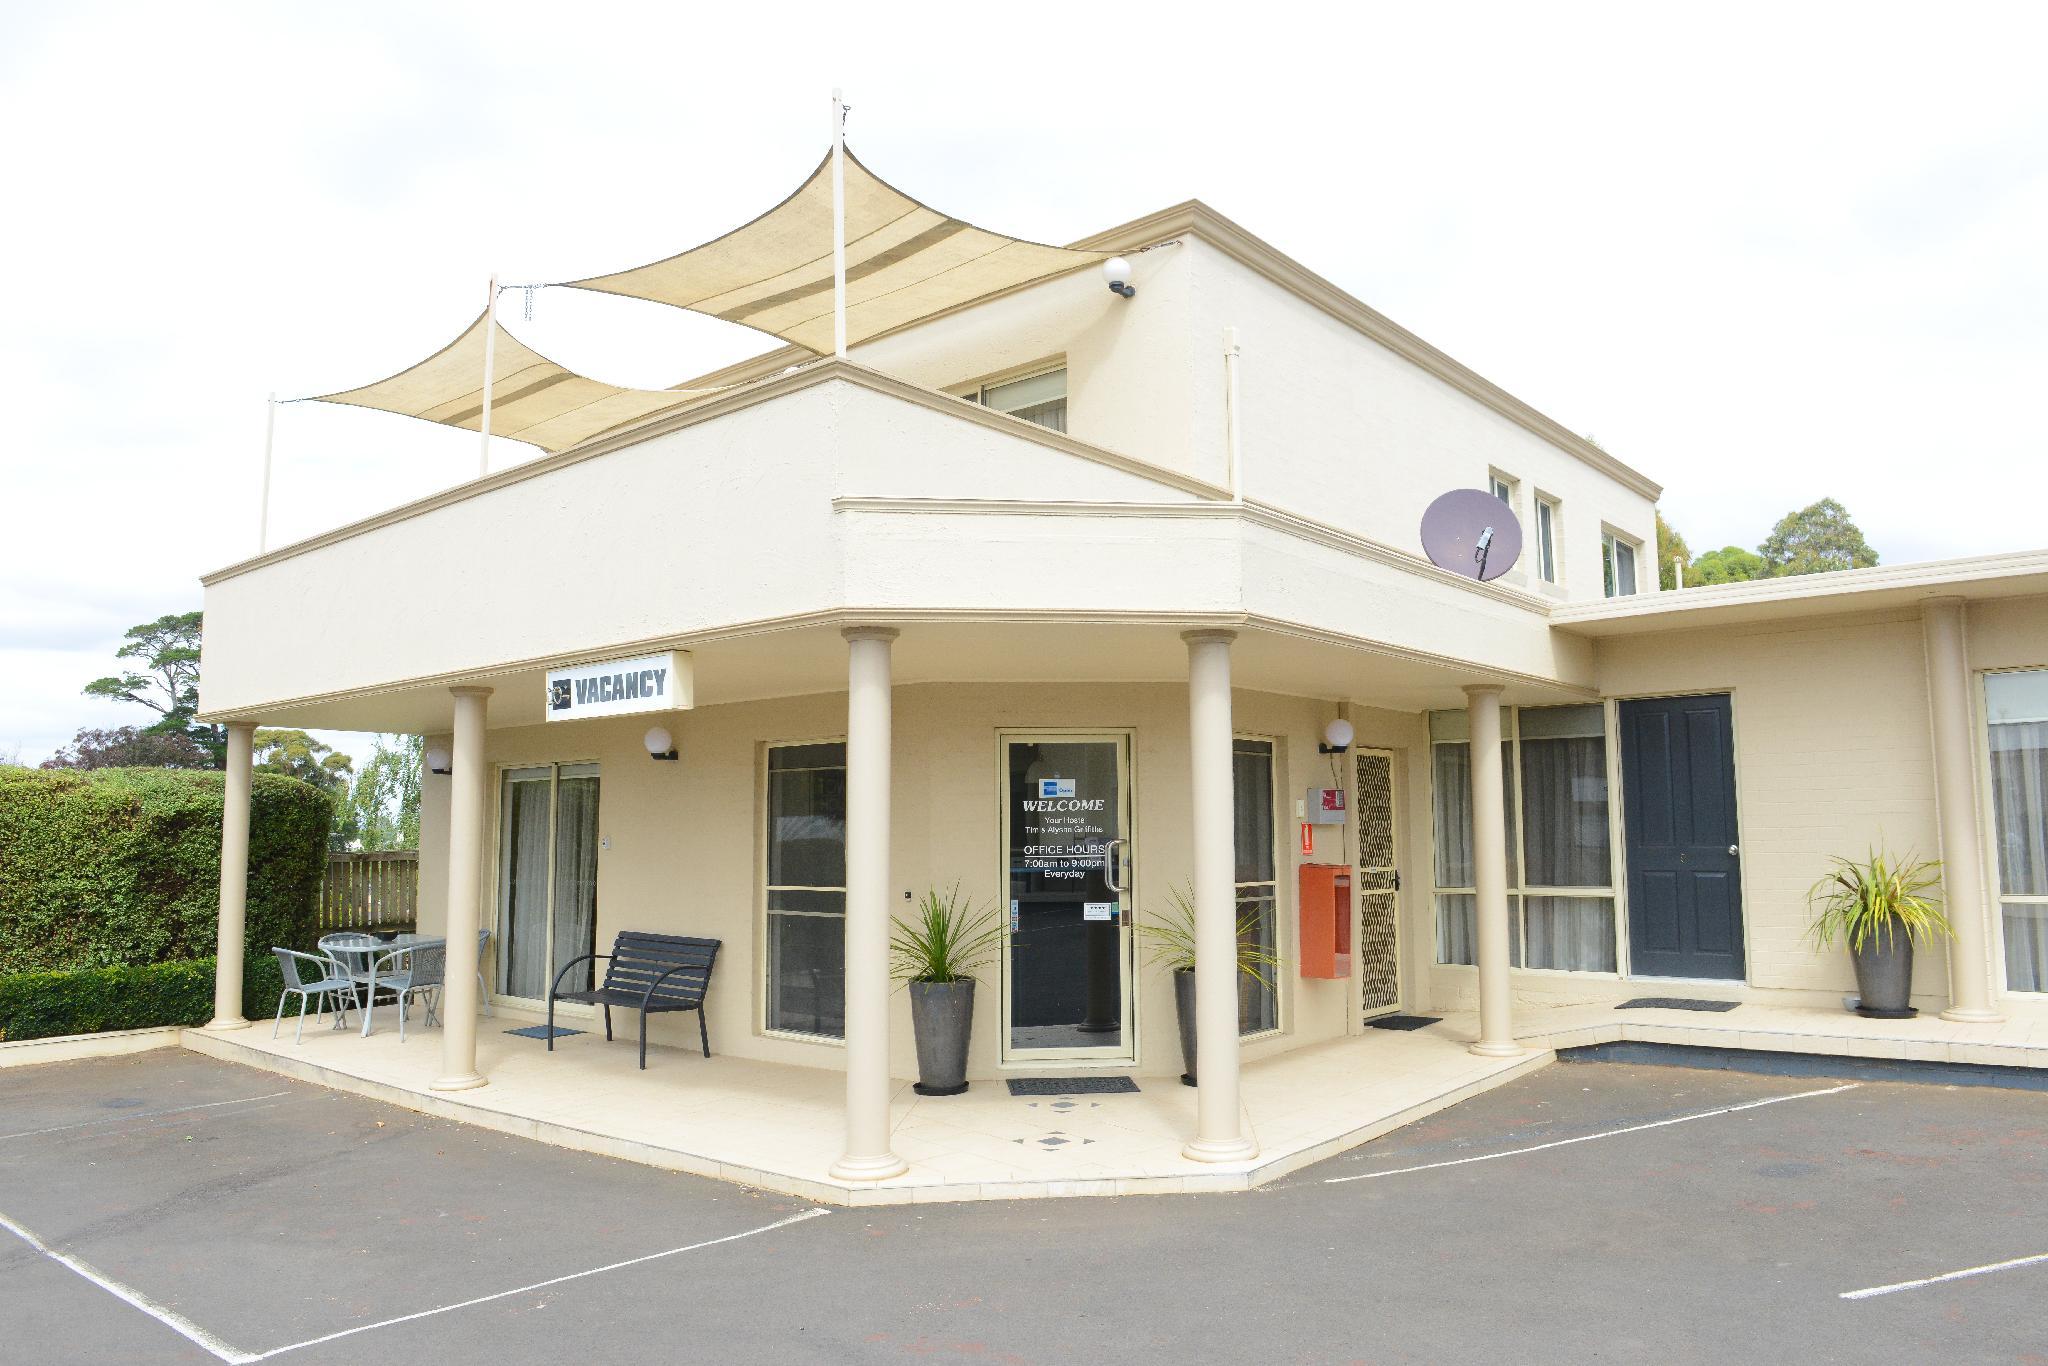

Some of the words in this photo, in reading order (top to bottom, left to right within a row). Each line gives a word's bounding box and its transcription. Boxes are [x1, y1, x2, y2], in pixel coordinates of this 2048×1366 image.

[575, 668, 667, 704] VACANCY
[1023, 800, 1105, 812] WELCOME
[1044, 816, 1062, 824] Your
[1063, 816, 1085, 824] Hosts
[1025, 826, 1039, 834] Tim
[1023, 845, 1063, 855] OFFICE
[1066, 845, 1105, 854] HOURS
[1024, 859, 1058, 868] 7:00am
[1060, 860, 1069, 868] to
[1071, 859, 1105, 869] 9:00pm
[1044, 870, 1085, 880] Everyday
